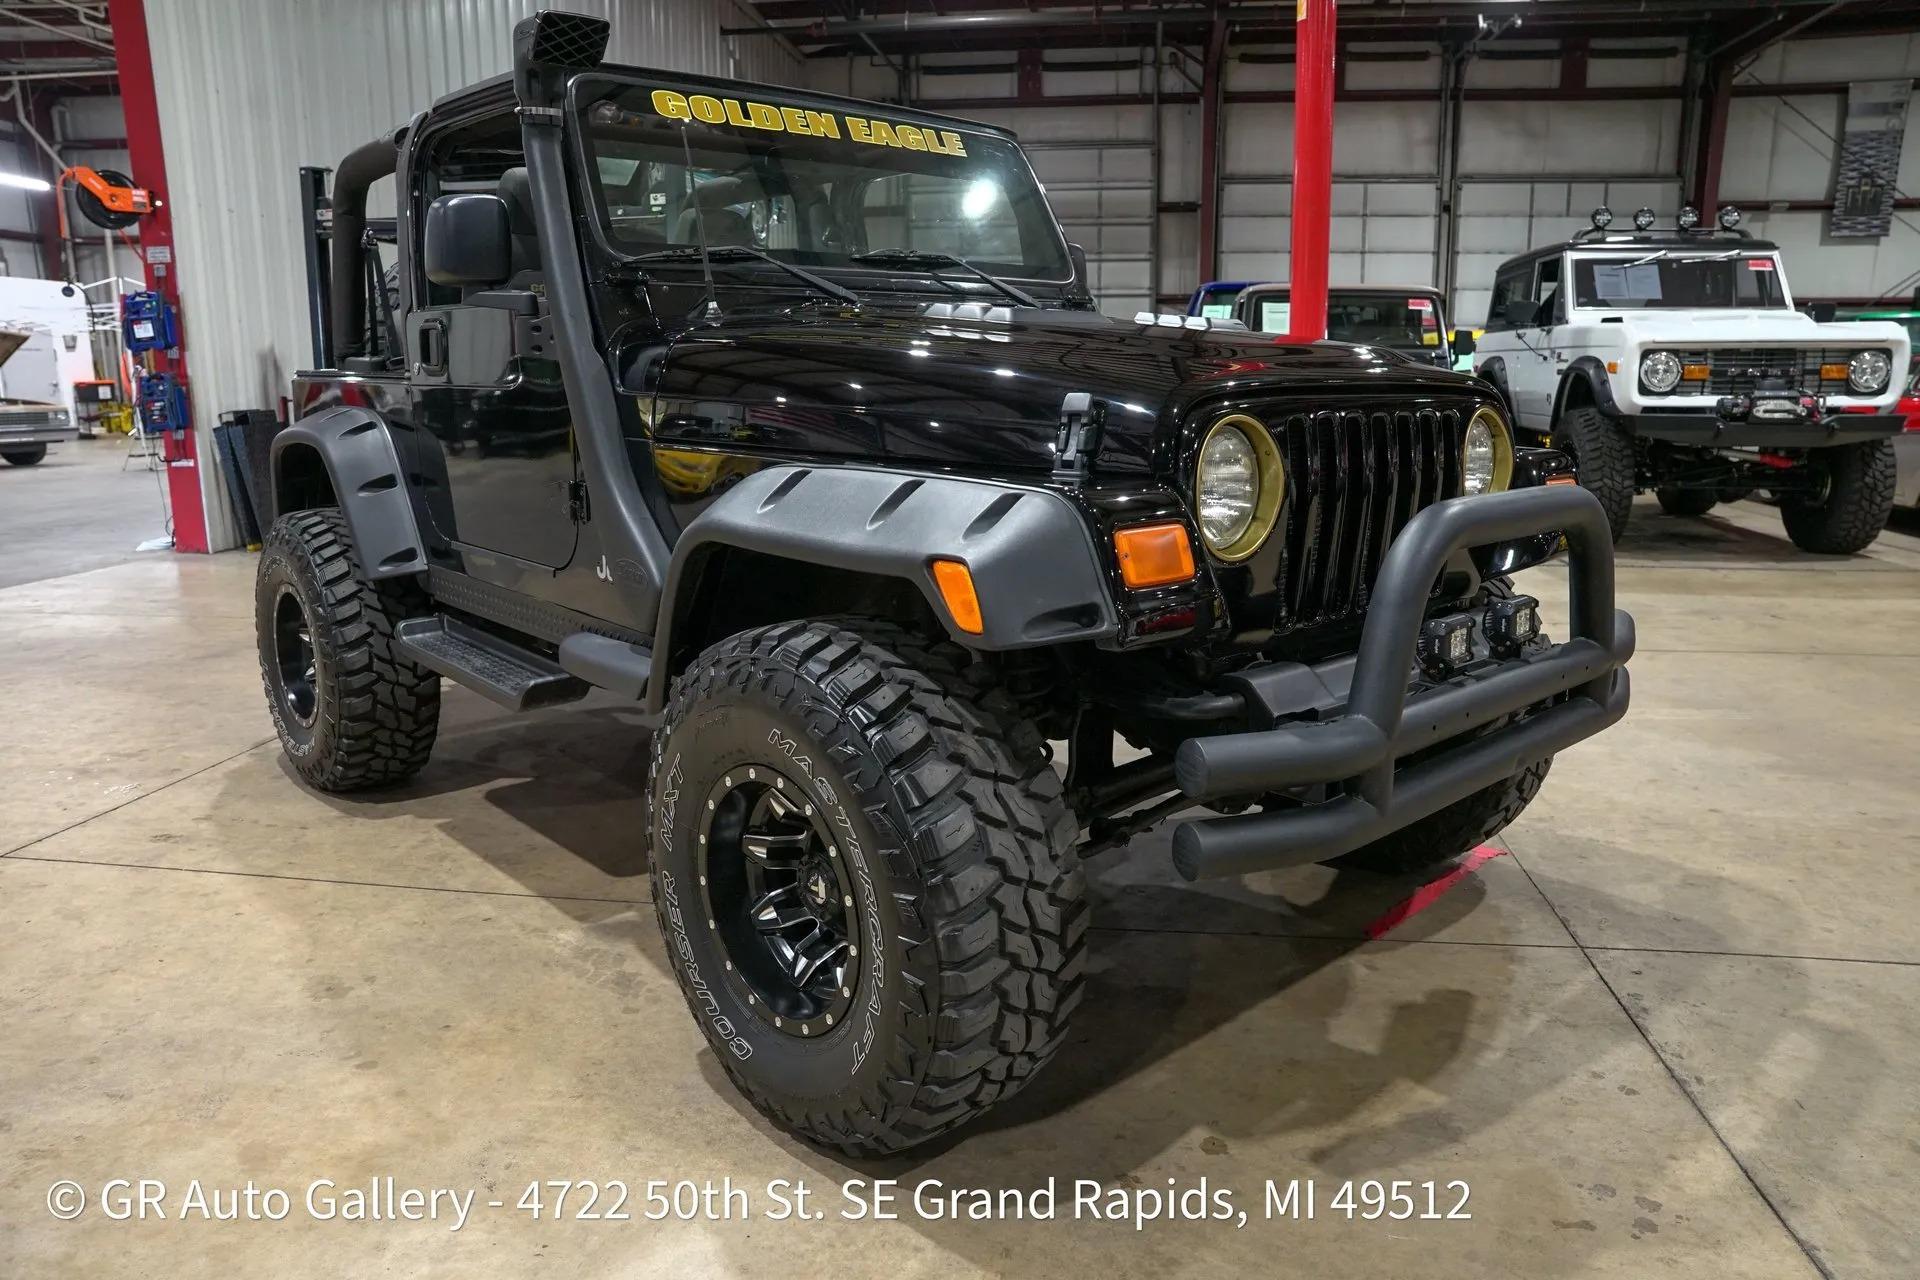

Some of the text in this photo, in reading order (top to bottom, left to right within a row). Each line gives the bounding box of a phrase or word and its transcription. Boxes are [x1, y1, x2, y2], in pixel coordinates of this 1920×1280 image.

[651, 89, 968, 157] GOLDEN EAGLE
[662, 869, 753, 1061] COURSER
[767, 727, 884, 1075] MASTERCRAFT
